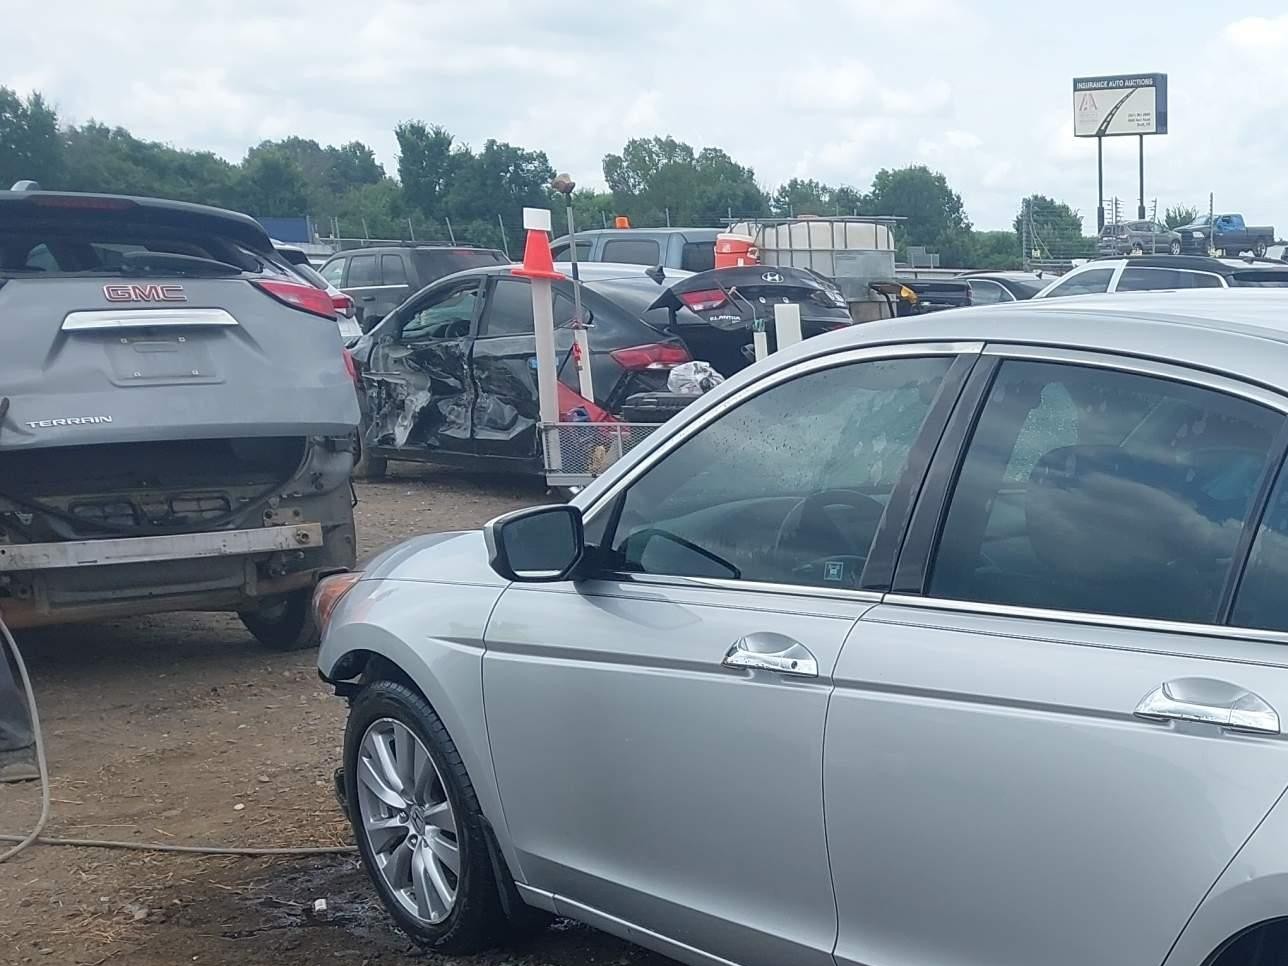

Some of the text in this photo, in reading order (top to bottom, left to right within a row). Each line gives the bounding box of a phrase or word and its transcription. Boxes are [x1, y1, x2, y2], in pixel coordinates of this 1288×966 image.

[1076, 78, 1153, 89] INSURANCE AUTO AUCTIONS
[103, 285, 187, 302] GMC
[26, 415, 113, 428] TERRAIN
